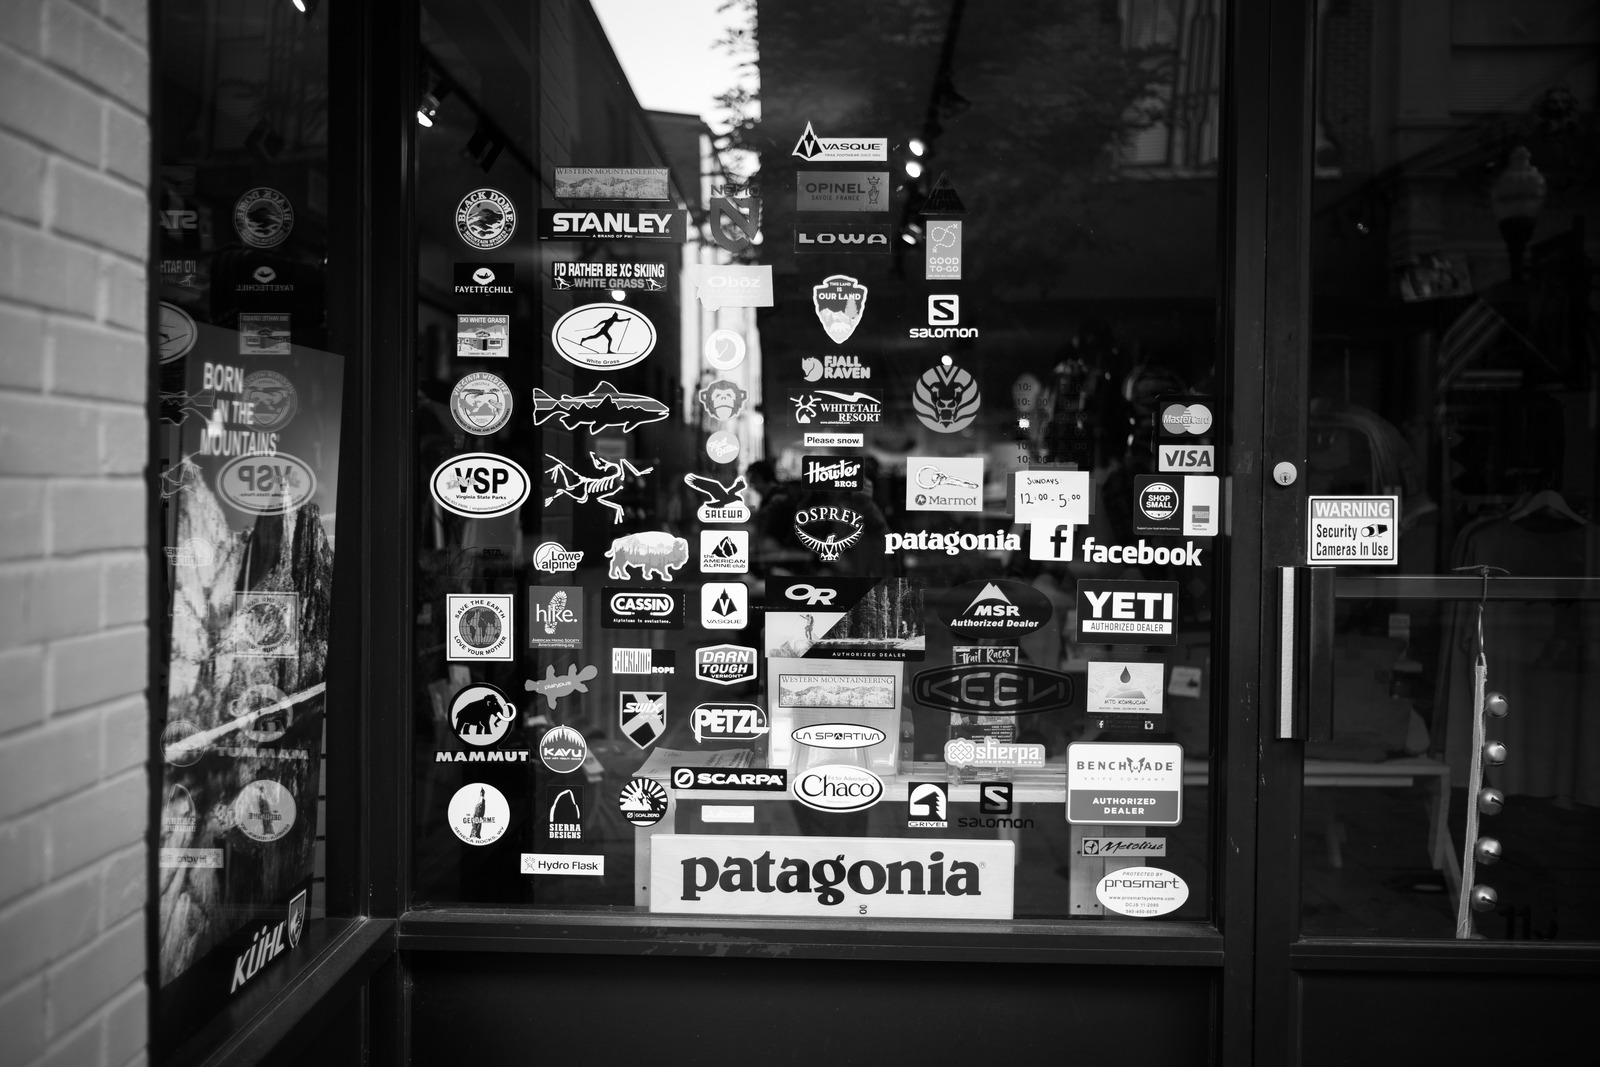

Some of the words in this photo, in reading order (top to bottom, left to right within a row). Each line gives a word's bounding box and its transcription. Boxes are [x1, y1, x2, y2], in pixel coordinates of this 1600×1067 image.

[595, 168, 667, 176] MOUNTAINEERING
[711, 184, 760, 196] NEMO
[806, 183, 866, 194] OPINEL
[458, 191, 487, 222] BLACK
[489, 192, 513, 222] DOME
[553, 212, 672, 233] STANLEY
[799, 233, 888, 245] LOWA
[929, 257, 959, 265] GOOD
[554, 262, 566, 277] I'D
[568, 262, 604, 277] RATHER
[605, 263, 617, 277] BE
[619, 263, 633, 277] XC
[635, 263, 664, 278] SKIING
[574, 278, 606, 289] WHITE
[608, 278, 645, 289] GRASS
[454, 286, 513, 294] FAYETTECHILL
[819, 293, 836, 301] OUR
[838, 293, 861, 301] LAND
[909, 327, 979, 338] salomon
[203, 361, 244, 393] BORN
[824, 367, 871, 379] RAVEN
[453, 373, 480, 396] VIRGINIA
[482, 373, 510, 394] WILDLIFE
[232, 400, 255, 425] THE
[820, 403, 882, 412] WHITETAIL
[838, 413, 881, 422] RESORT
[1163, 414, 1211, 425] MasterCard
[200, 428, 277, 456] MOUNTAINS
[806, 436, 835, 444] Please
[1165, 450, 1212, 467] VISA
[804, 460, 861, 484] Howler
[455, 467, 509, 494] VSP
[834, 480, 858, 488] BROS
[928, 495, 977, 506] Marmot
[1148, 494, 1171, 502] SHOP
[705, 509, 743, 519] SALEWA
[1315, 502, 1391, 517] WARNING
[1316, 524, 1358, 541] Security
[884, 529, 1021, 555] patagonia
[1082, 537, 1203, 567] facebook
[1316, 542, 1357, 556] Cameras
[1360, 542, 1369, 556] In
[1372, 542, 1389, 556] Use
[551, 550, 581, 561] Lowe
[541, 560, 576, 573] alpine
[785, 583, 838, 605] OR
[455, 603, 469, 619] SAVE
[486, 601, 506, 619] EARTH
[615, 597, 670, 611] CASSIN
[1083, 591, 1174, 620] YETI
[974, 605, 1021, 616] MSR
[951, 618, 1008, 628] Authorized
[1010, 619, 1039, 628] Dealer
[1090, 622, 1135, 632] AUTHORIZED
[1136, 623, 1164, 632] DEALER
[454, 635, 467, 650] LOVE
[467, 648, 484, 656] YOUR
[485, 636, 507, 655] MOTHER
[702, 651, 750, 663] DARN
[958, 649, 982, 664] Trail
[986, 648, 1011, 664] Races
[652, 666, 675, 674] ROPE
[702, 663, 749, 674] TOUGH
[544, 680, 572, 690] platypus
[820, 677, 893, 685] MOUNTAINEERING
[929, 672, 1059, 707] KEEN
[695, 708, 769, 743] PETZL
[795, 732, 811, 740] LA
[815, 732, 881, 741] SPORTIVA
[436, 750, 529, 762] MAMMUT
[544, 747, 582, 757] KAVU
[976, 738, 1039, 764] sherpa
[1077, 757, 1172, 773] BENCHMADE
[697, 773, 781, 787] SCARPA
[801, 774, 875, 798] Chaco
[1092, 797, 1157, 805] AUTHORIZED
[1104, 807, 1145, 815] DEALER
[549, 823, 581, 831] SIERRA
[958, 816, 1034, 829] salomon
[454, 826, 474, 843] SENECA
[549, 831, 581, 839] DESIGNS
[1100, 841, 1164, 853] Metolius
[538, 860, 570, 872] Hydro
[572, 861, 599, 870] Flask
[680, 851, 982, 906] patagonia
[1104, 877, 1180, 892] prosmart
[230, 921, 285, 994] KÜHL
